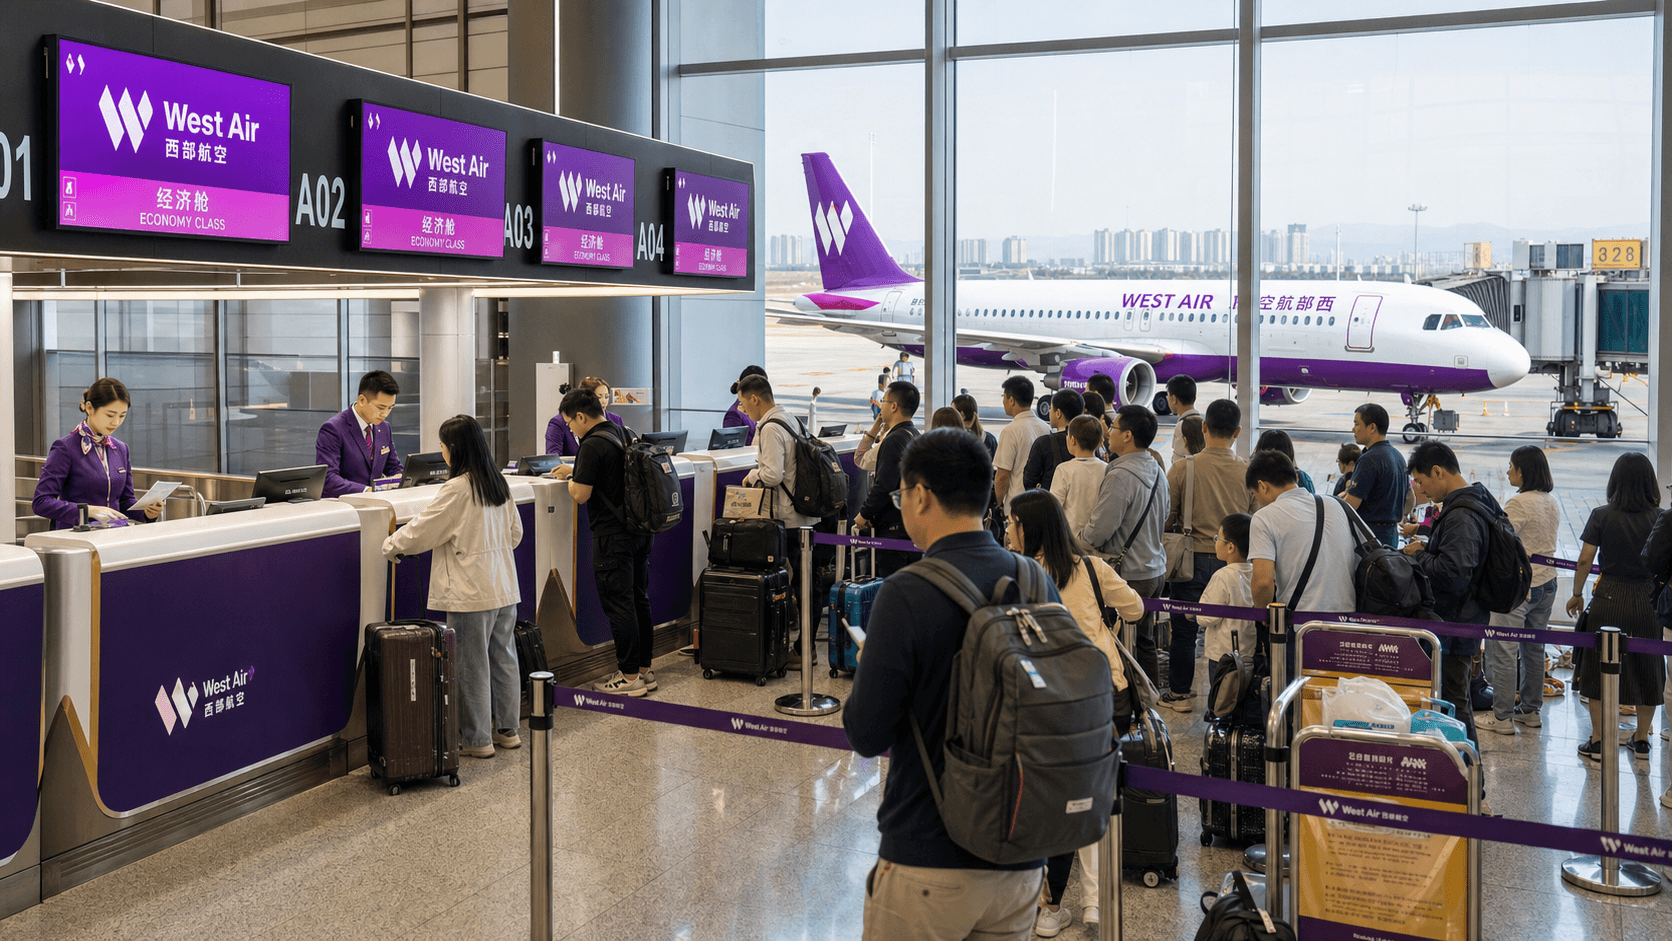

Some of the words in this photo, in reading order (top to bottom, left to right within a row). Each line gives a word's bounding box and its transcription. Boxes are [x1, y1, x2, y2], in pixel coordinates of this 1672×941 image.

[163, 101, 223, 137] West
[227, 112, 260, 142] Air
[165, 138, 227, 164] 西部航空
[427, 147, 466, 175] West
[468, 155, 489, 178] Air
[428, 176, 468, 196] 西部航空
[585, 178, 611, 200] West
[612, 183, 626, 202] Air
[157, 187, 209, 212] 经济舱
[295, 173, 345, 229] A02
[708, 199, 728, 219] West
[729, 203, 741, 219] Air
[140, 212, 192, 228] ECONOMY
[195, 217, 226, 230] CLASS
[422, 215, 455, 236] 经济舱
[504, 202, 533, 249] A03
[636, 222, 664, 261] A04
[1598, 246, 1635, 263] 328
[1122, 293, 1176, 309] WEST
[1177, 294, 1214, 310] AIR
[1233, 295, 1336, 312] 空航部西
[203, 674, 231, 698] West
[232, 669, 248, 689] Air
[1341, 804, 1365, 817] West
[1366, 808, 1380, 819] Air
